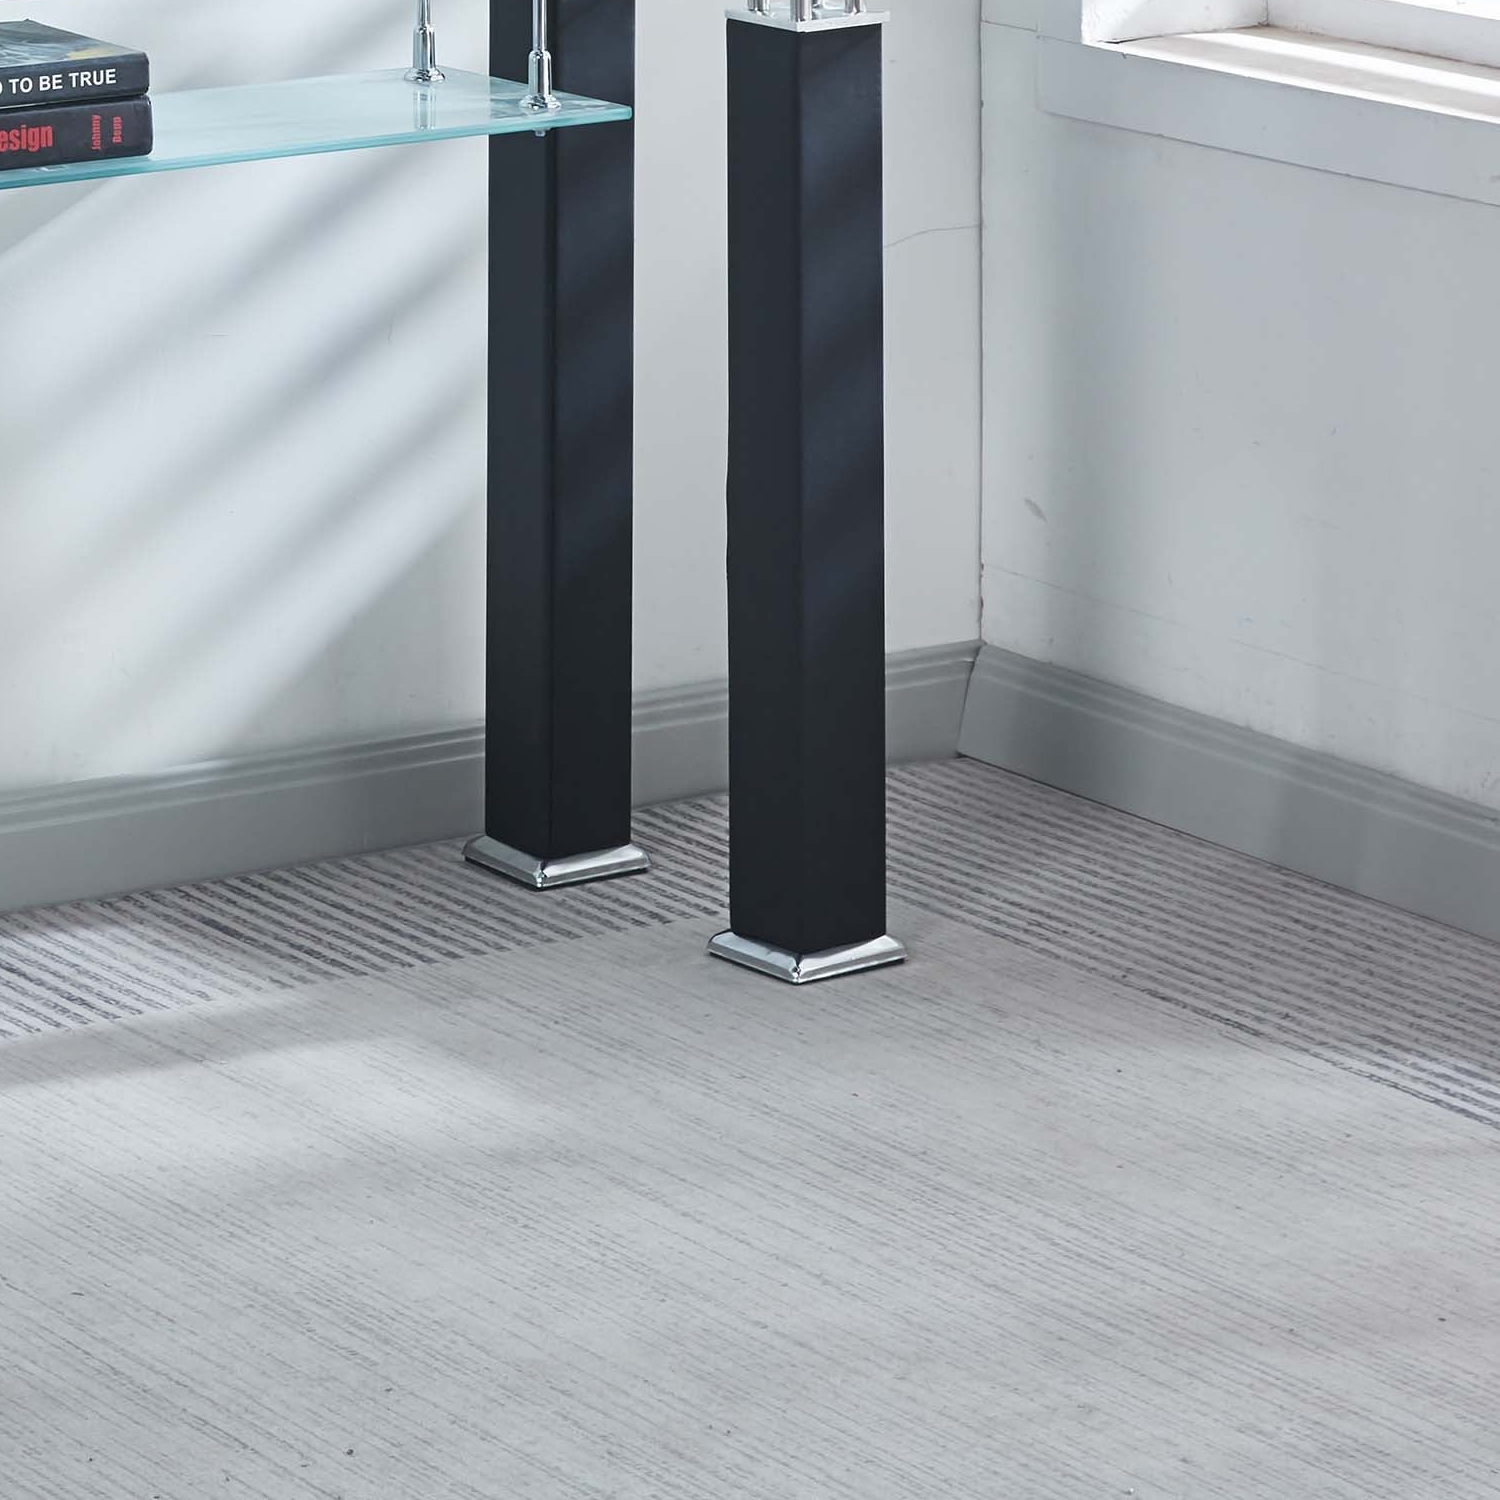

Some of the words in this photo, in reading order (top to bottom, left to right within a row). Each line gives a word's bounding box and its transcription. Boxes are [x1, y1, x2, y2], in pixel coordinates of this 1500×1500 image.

[8, 76, 33, 94] TO
[38, 73, 63, 91] BE
[68, 68, 117, 88] TRUE
